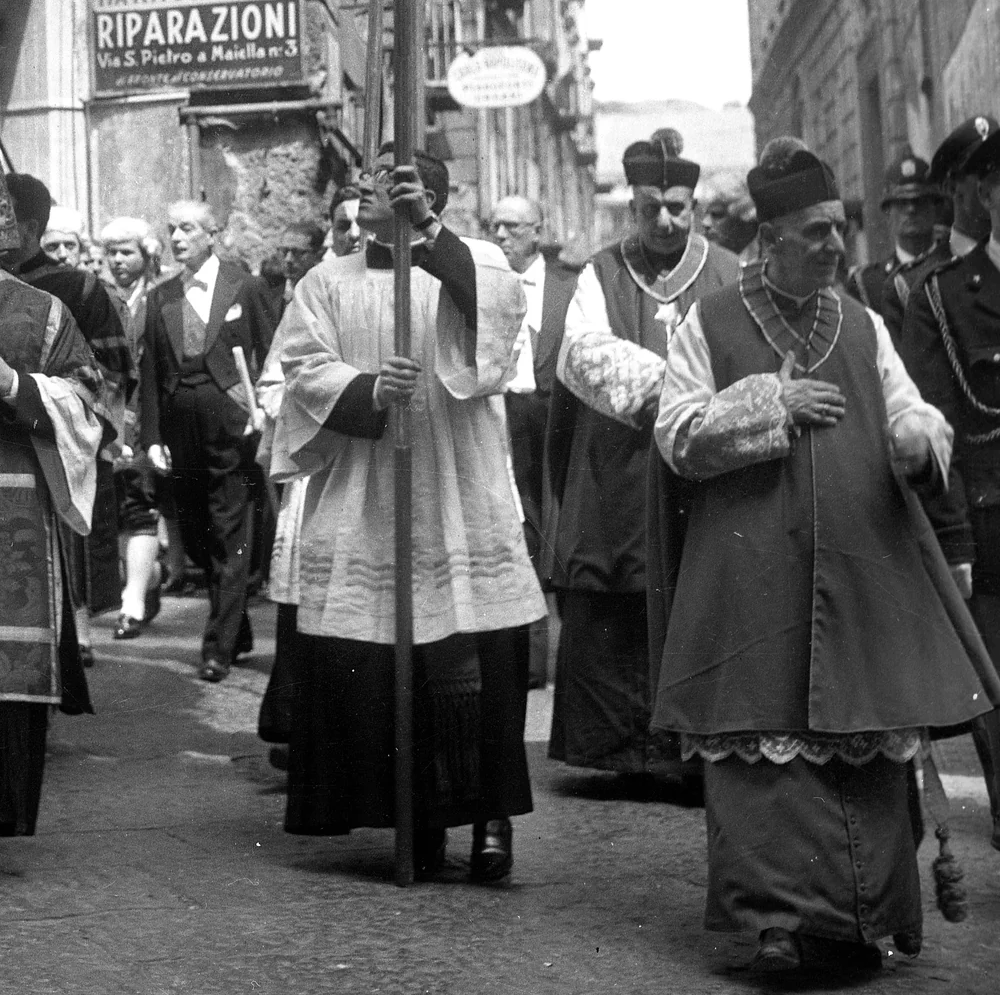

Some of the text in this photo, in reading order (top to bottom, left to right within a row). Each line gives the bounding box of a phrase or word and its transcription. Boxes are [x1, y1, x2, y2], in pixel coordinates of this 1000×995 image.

[98, 1, 297, 48] RIPARAZIONI
[97, 50, 121, 68] Via
[141, 48, 193, 66] Pietro
[196, 51, 207, 63] a
[211, 42, 266, 61] Maiella
[284, 39, 298, 57] 3
